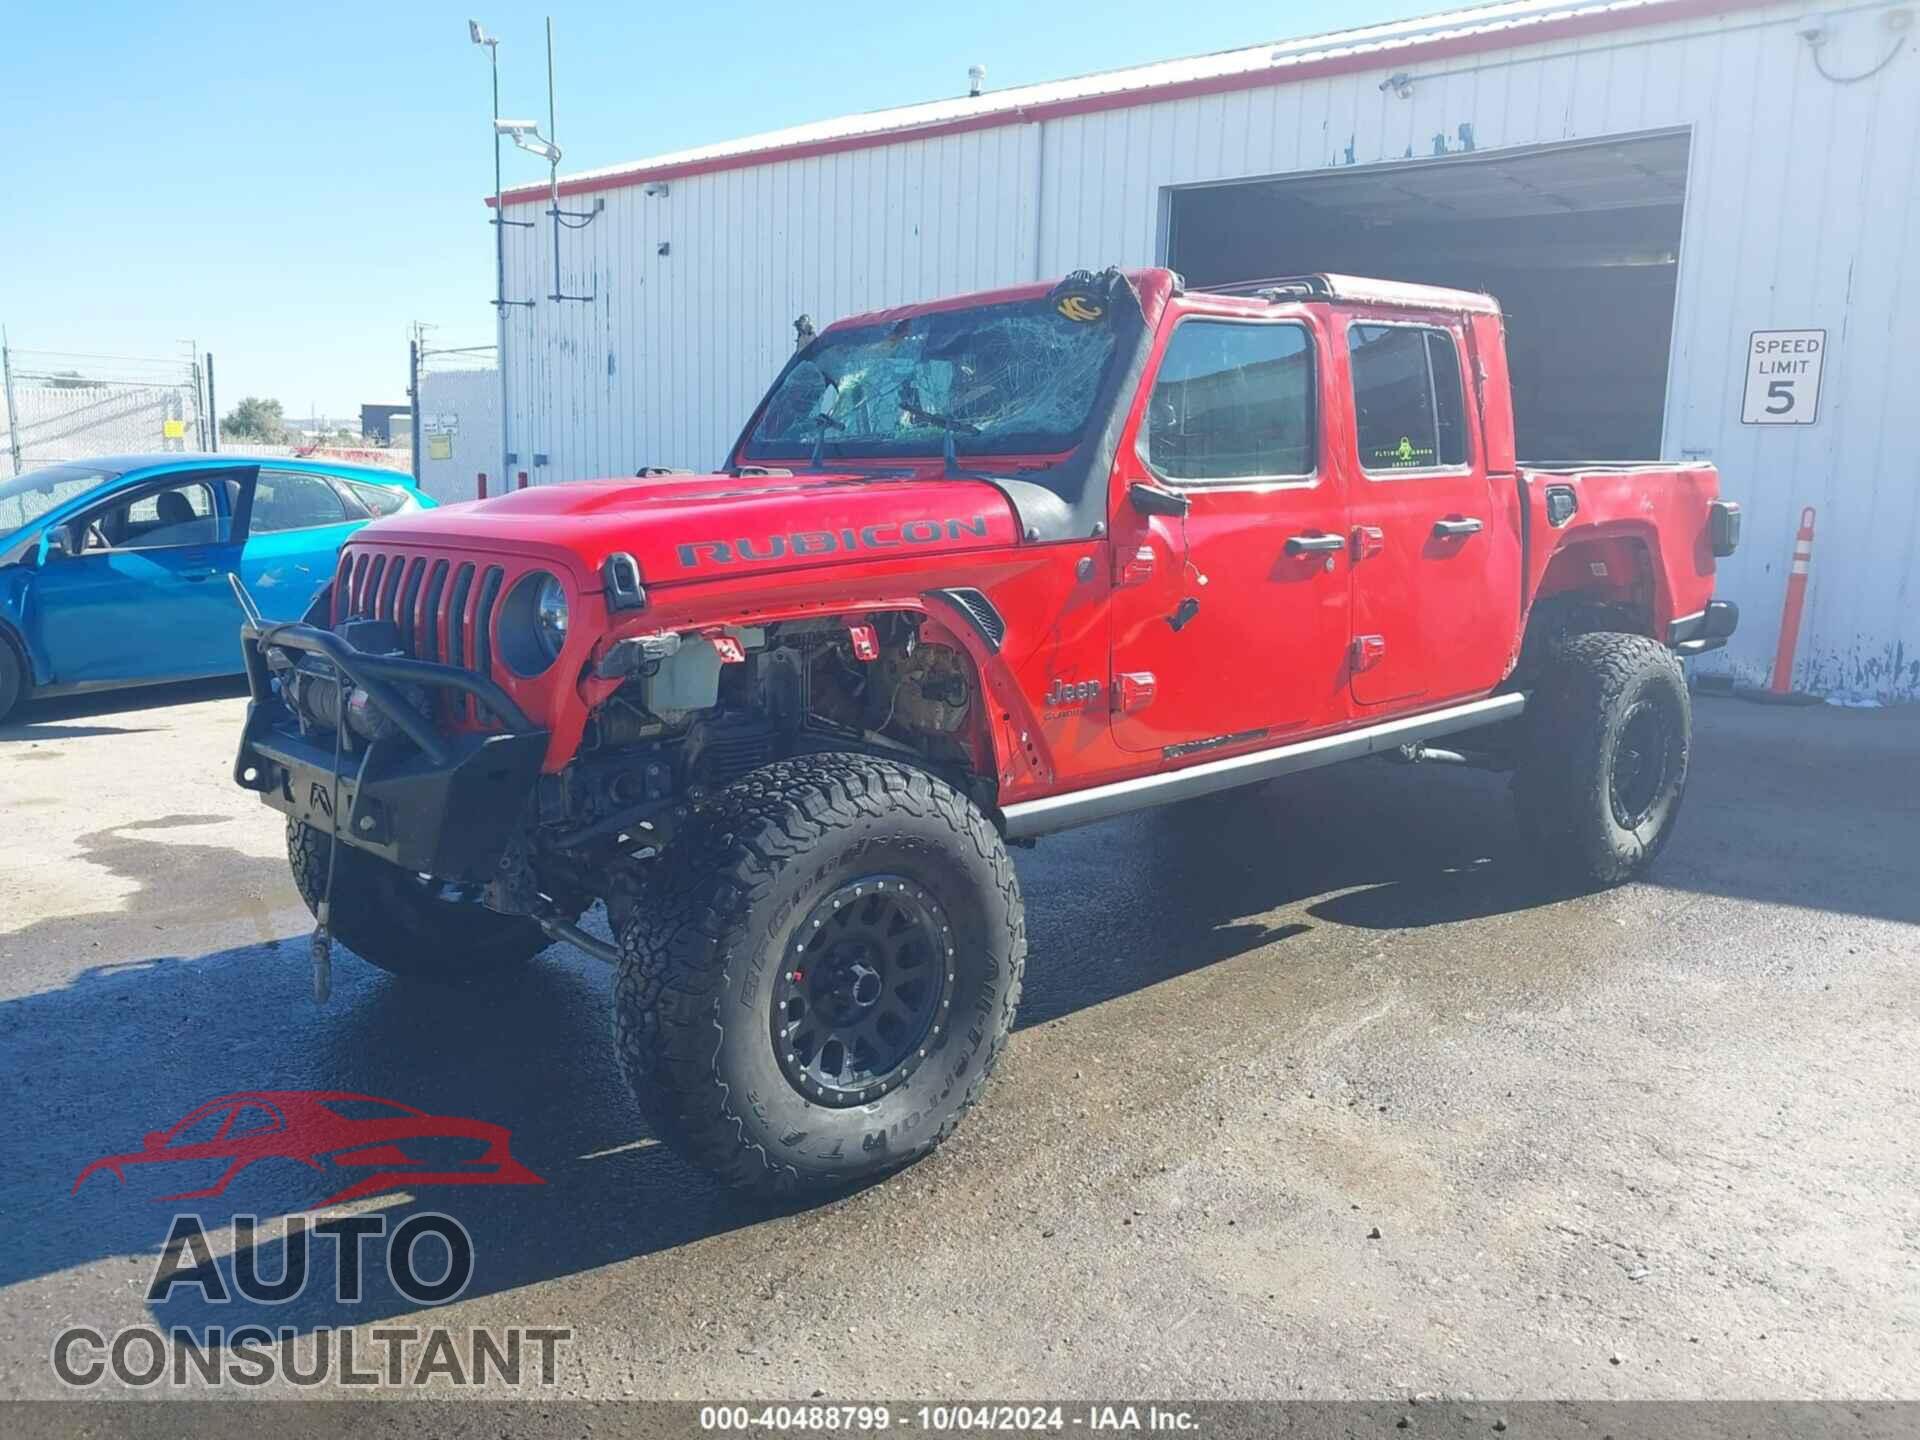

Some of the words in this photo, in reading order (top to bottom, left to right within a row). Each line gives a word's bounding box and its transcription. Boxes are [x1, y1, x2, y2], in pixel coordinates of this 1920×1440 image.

[1058, 296, 1103, 321] KC
[1754, 339, 1820, 354] SPEED
[1759, 360, 1811, 375] LIMIT
[1765, 380, 1796, 415] 5
[675, 513, 989, 569] RUBICON
[1045, 679, 1101, 705] Jeep
